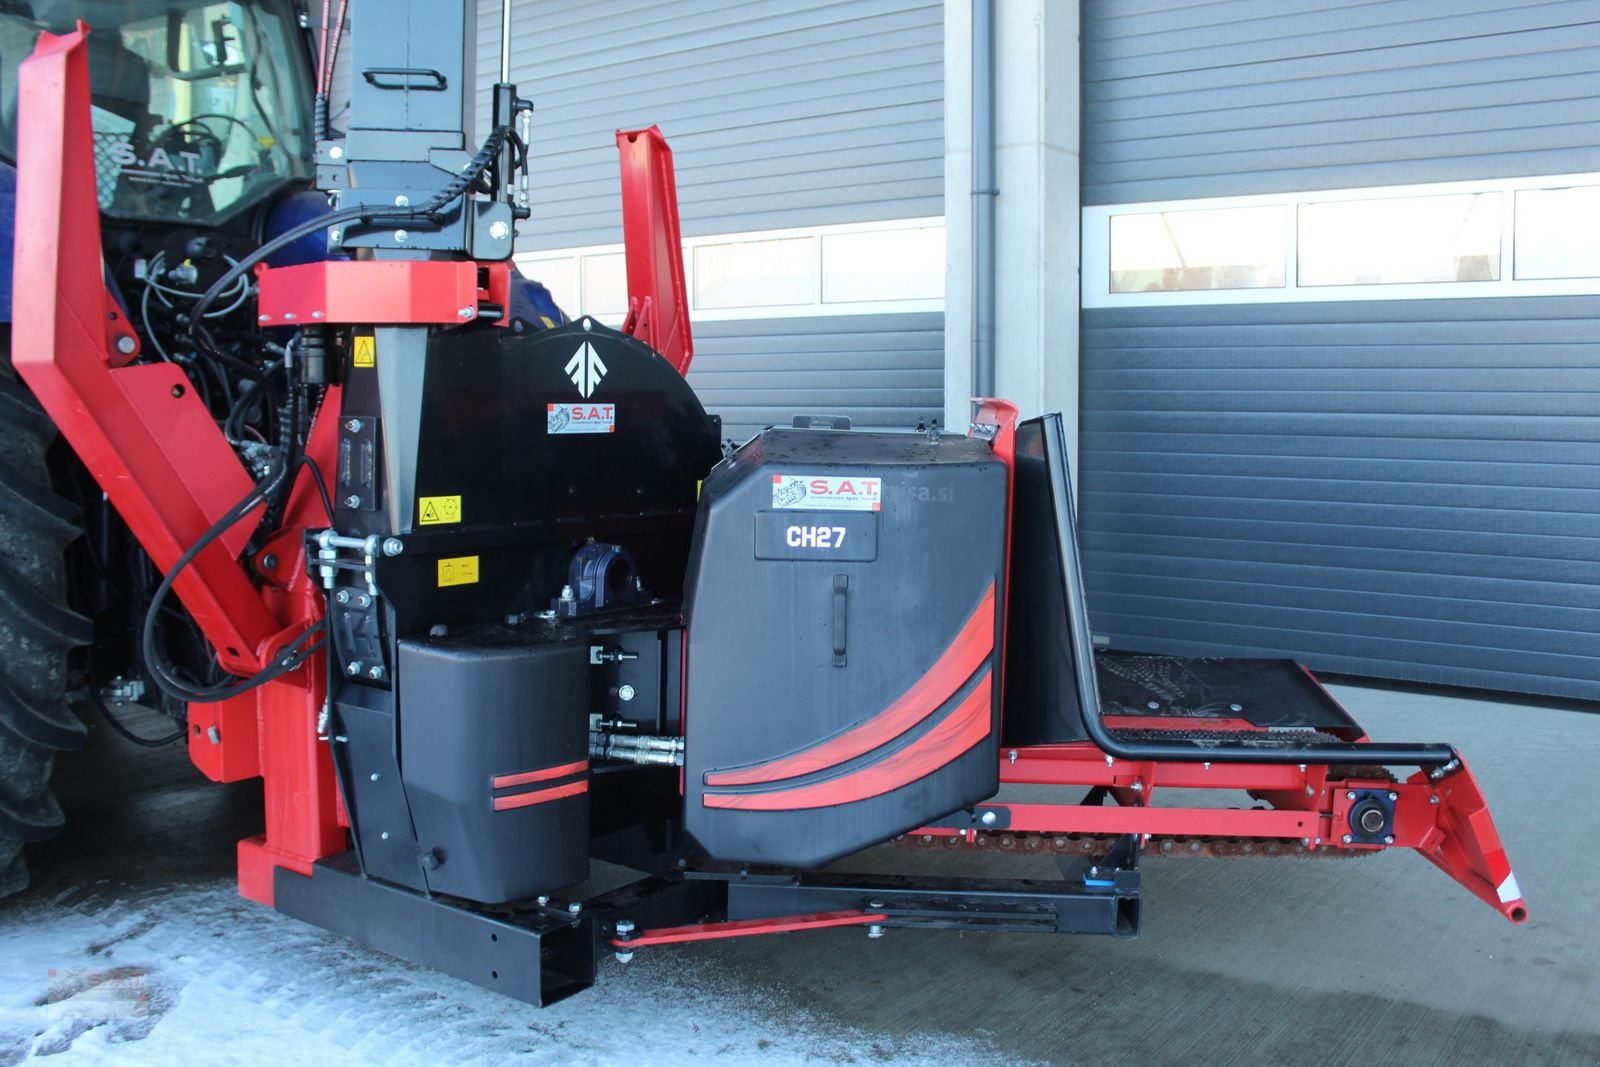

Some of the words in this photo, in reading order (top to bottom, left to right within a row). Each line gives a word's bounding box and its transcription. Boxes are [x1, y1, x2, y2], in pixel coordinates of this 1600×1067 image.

[110, 142, 203, 175] S.A.T.
[572, 407, 613, 420] S.A.T.
[809, 479, 879, 496] S.A.T.
[786, 526, 847, 548] CH27
